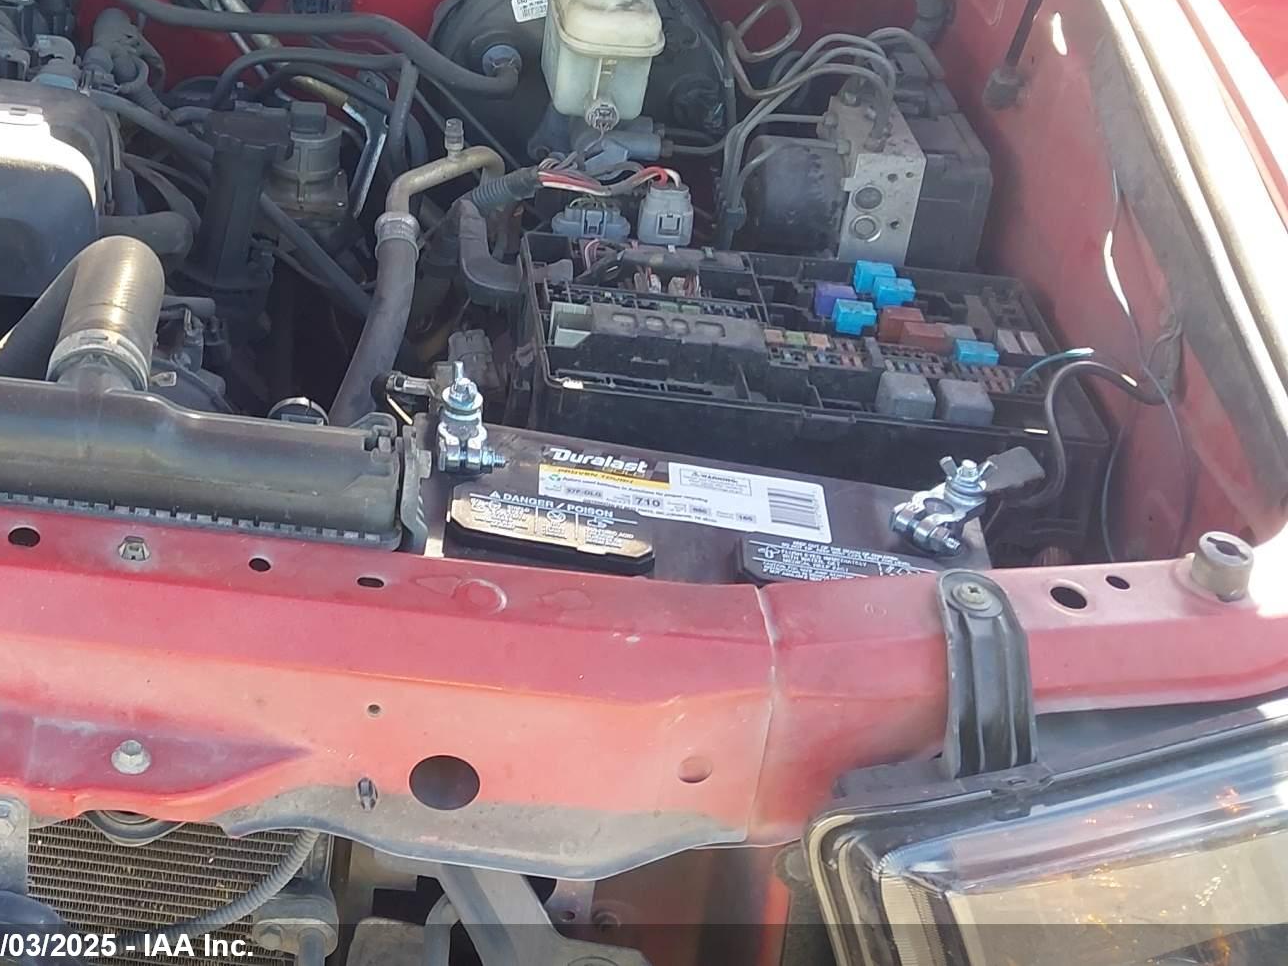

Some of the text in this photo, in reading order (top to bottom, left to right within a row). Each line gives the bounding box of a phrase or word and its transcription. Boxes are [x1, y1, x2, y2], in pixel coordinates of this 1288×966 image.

[549, 447, 648, 473] Duralast
[503, 494, 554, 507] DANGER
[567, 504, 614, 516] POISON
[635, 497, 660, 507] 710
